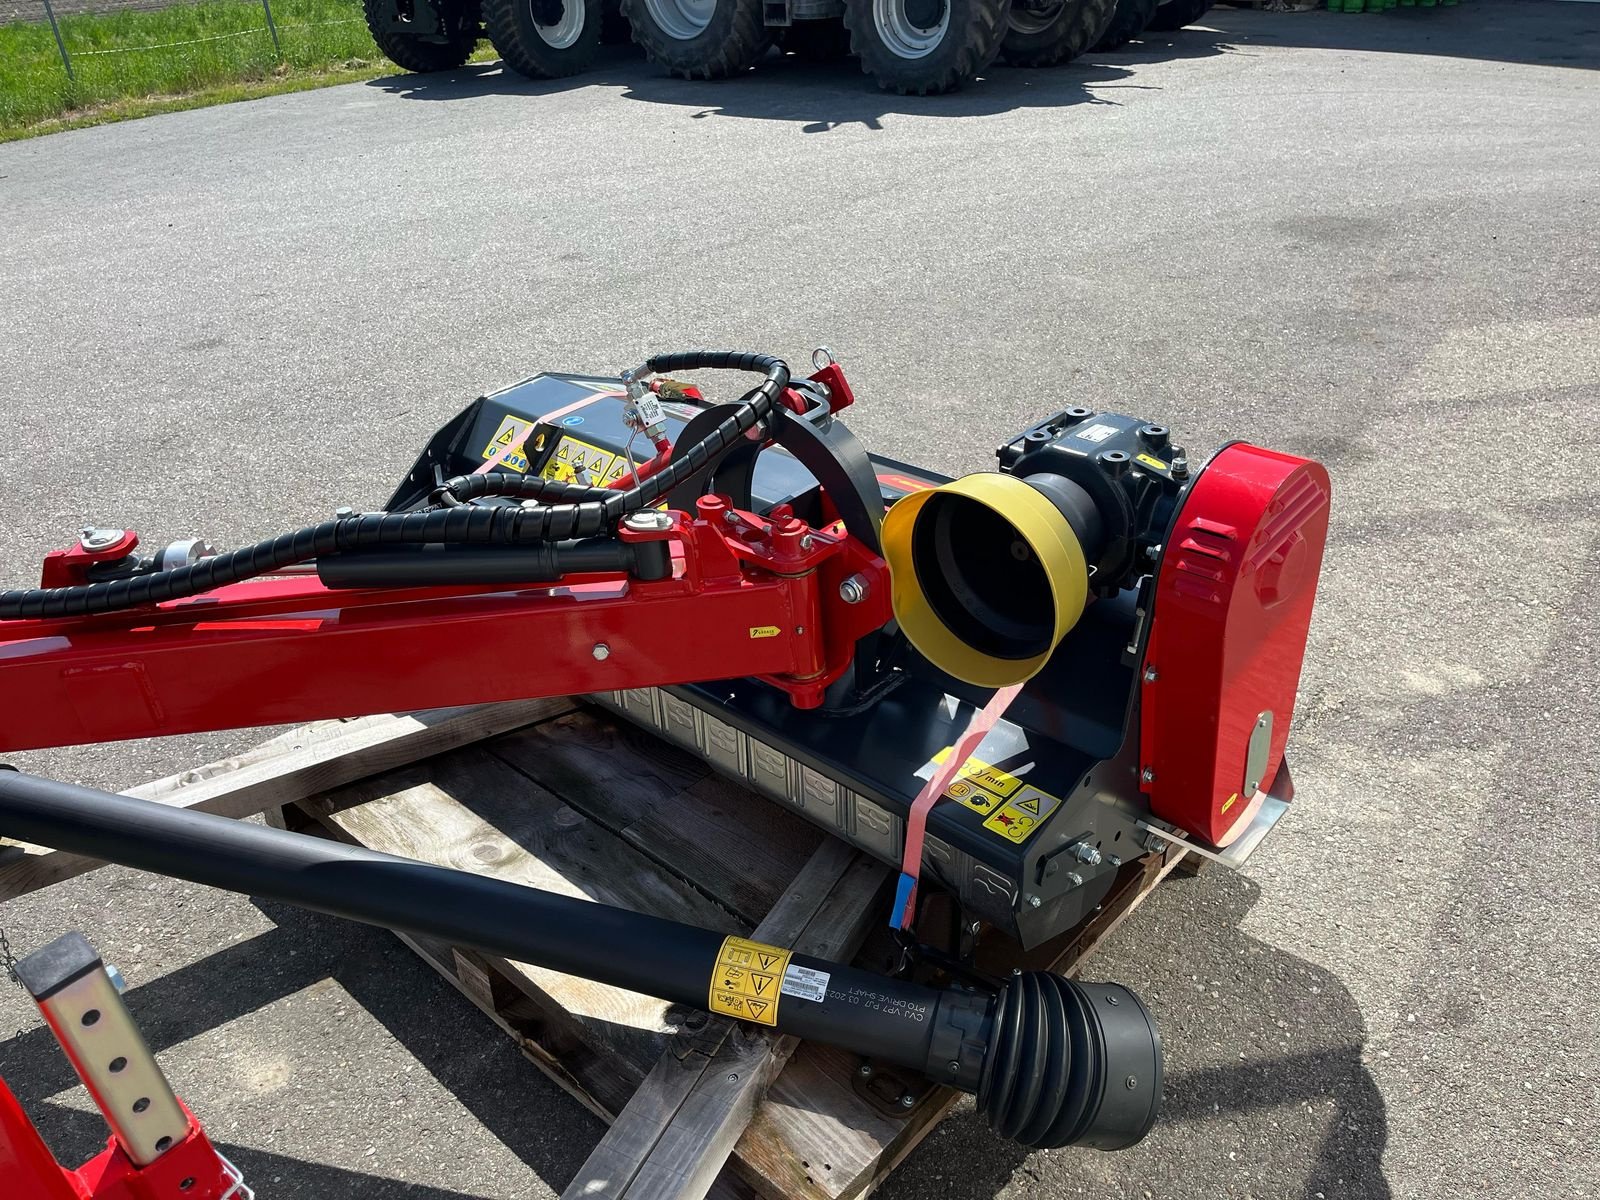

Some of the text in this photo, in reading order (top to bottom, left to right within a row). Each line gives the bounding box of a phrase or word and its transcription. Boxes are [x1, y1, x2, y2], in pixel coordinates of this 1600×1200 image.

[848, 987, 925, 1012] PTO DRIVE SHAFT
[882, 1005, 901, 1015] VP7
